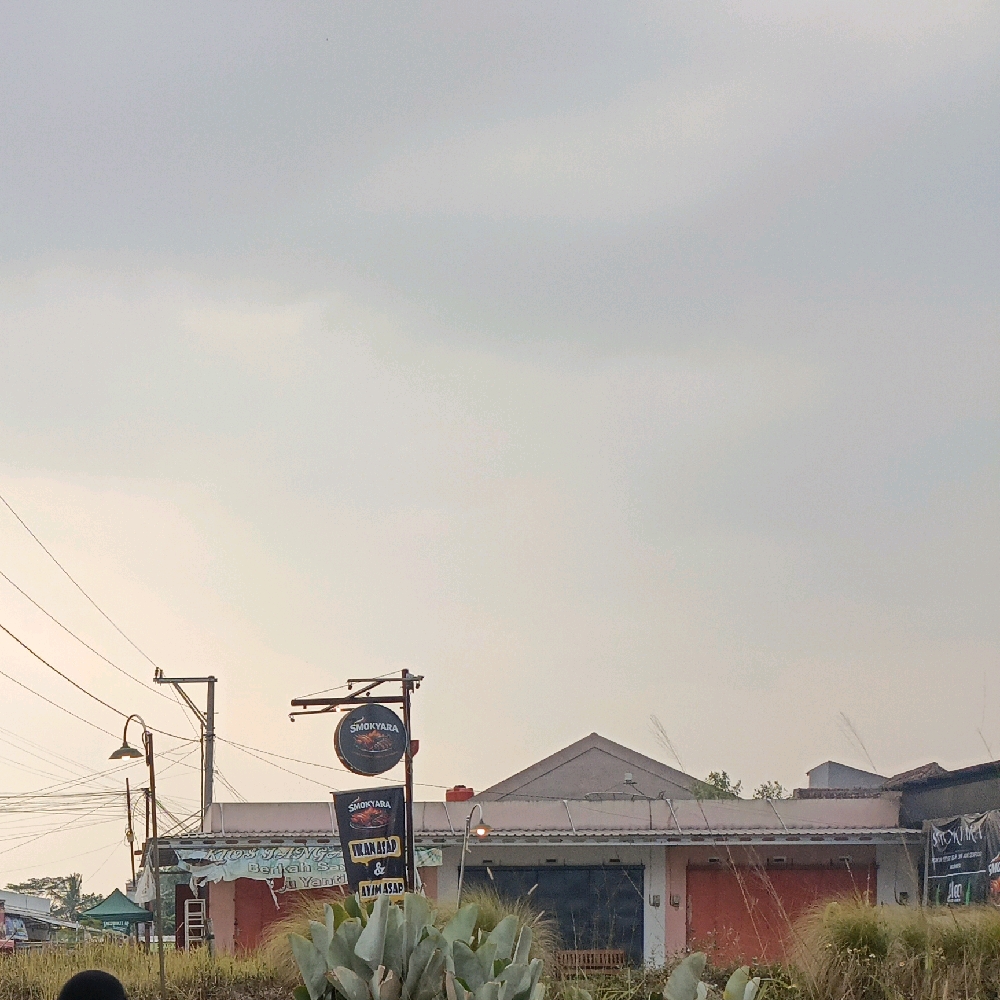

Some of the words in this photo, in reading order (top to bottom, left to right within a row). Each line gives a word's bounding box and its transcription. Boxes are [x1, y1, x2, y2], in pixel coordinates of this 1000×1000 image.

[350, 722, 399, 734] SMOKYARA
[348, 799, 391, 813] SMOKYARA
[377, 839, 397, 854] ASAP
[373, 861, 386, 876] &
